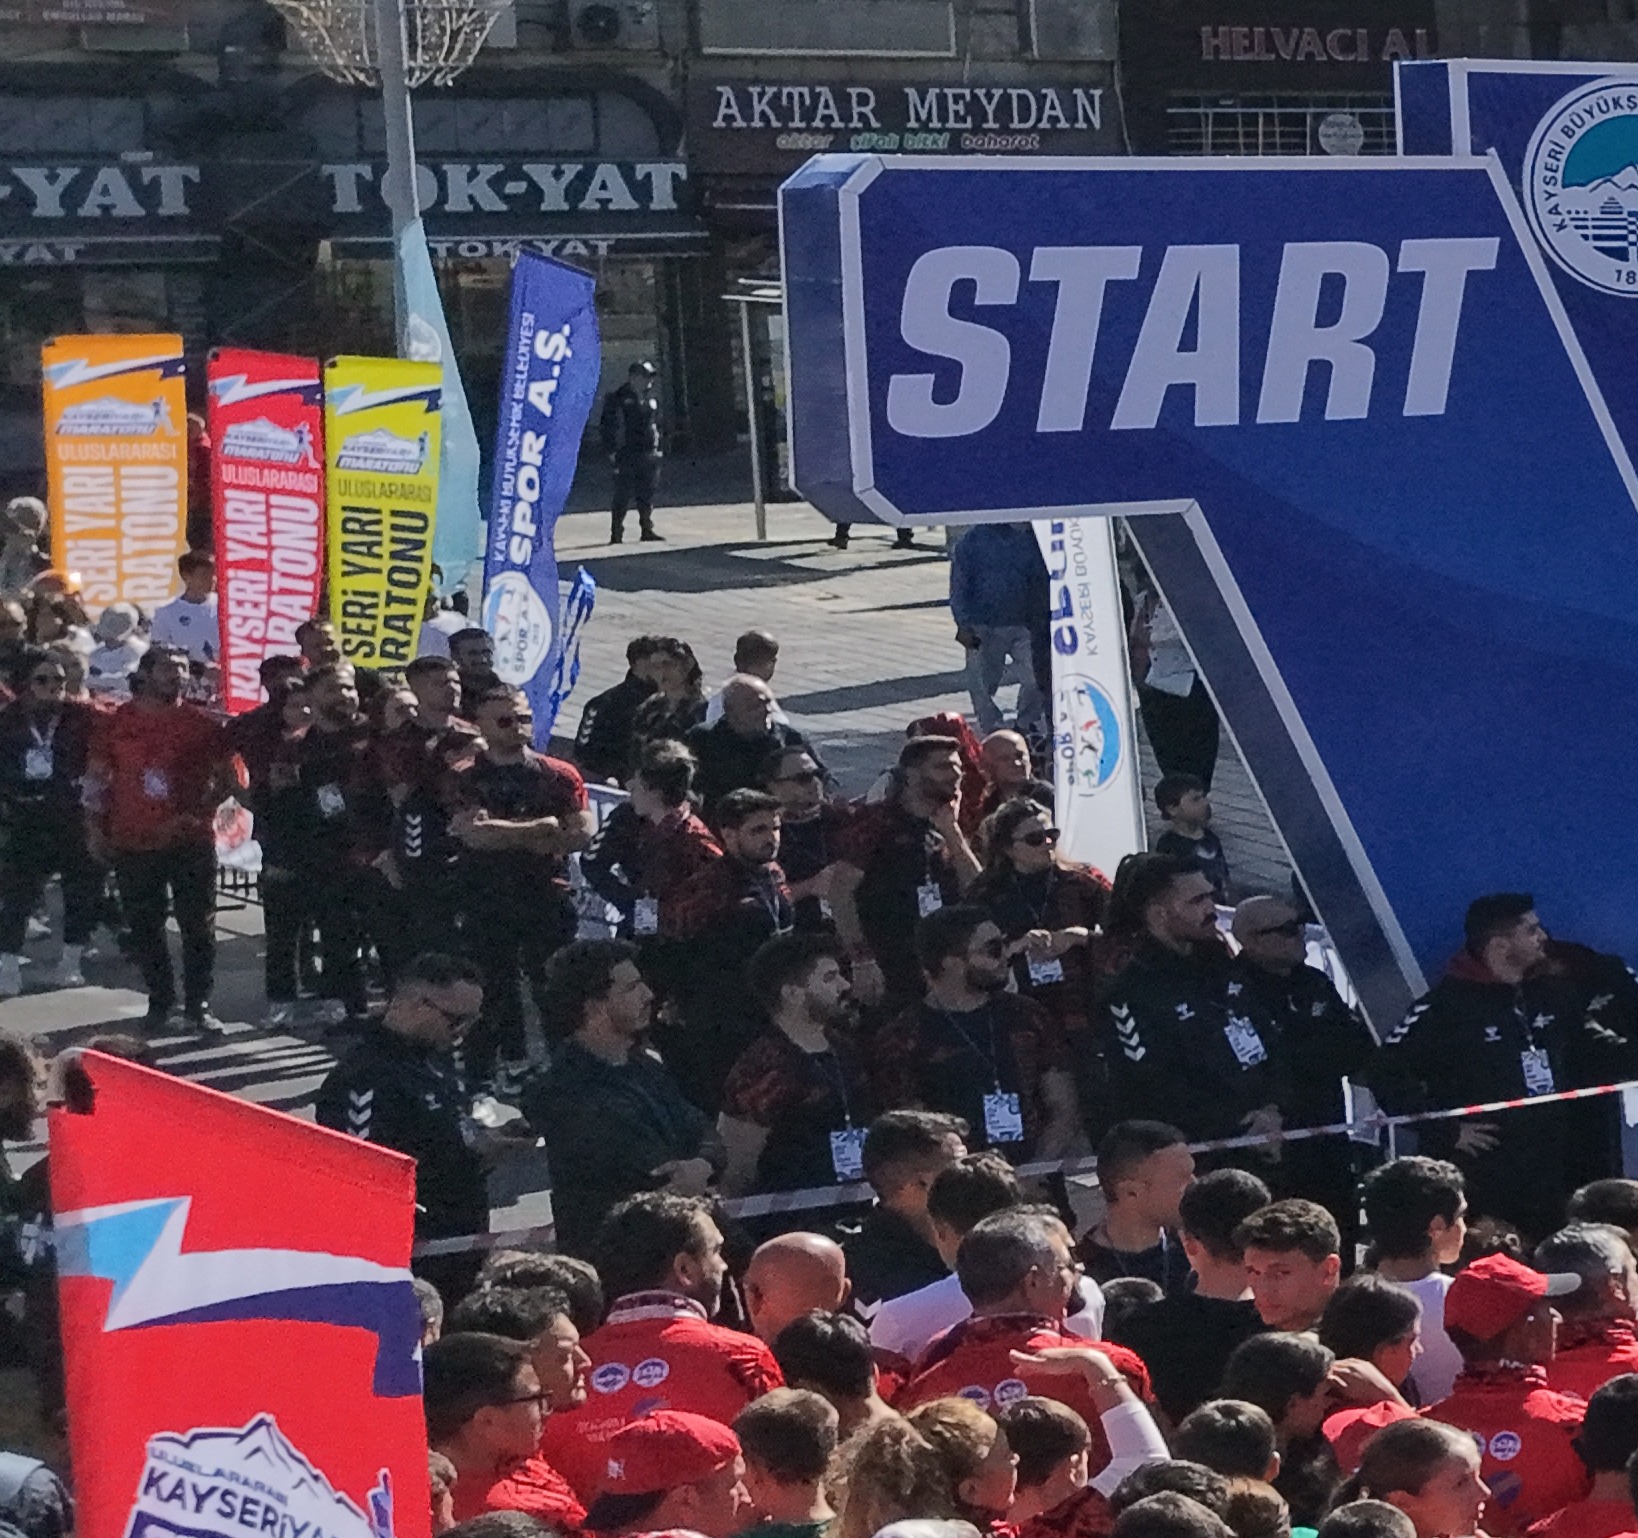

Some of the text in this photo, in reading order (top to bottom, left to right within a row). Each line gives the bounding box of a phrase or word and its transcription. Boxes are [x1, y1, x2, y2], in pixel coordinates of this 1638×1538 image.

[1201, 26, 1369, 61] HELVACI
[713, 86, 1103, 129] AKTAR MEYDAN
[321, 162, 688, 213] TOK-YAT
[1543, 139, 1568, 233] KAYSERİ
[885, 237, 1502, 438] START
[63, 466, 116, 534] YARI
[511, 429, 547, 565] SPOR
[341, 505, 384, 586] YARI
[223, 489, 268, 703] KAYSERİ YARI
